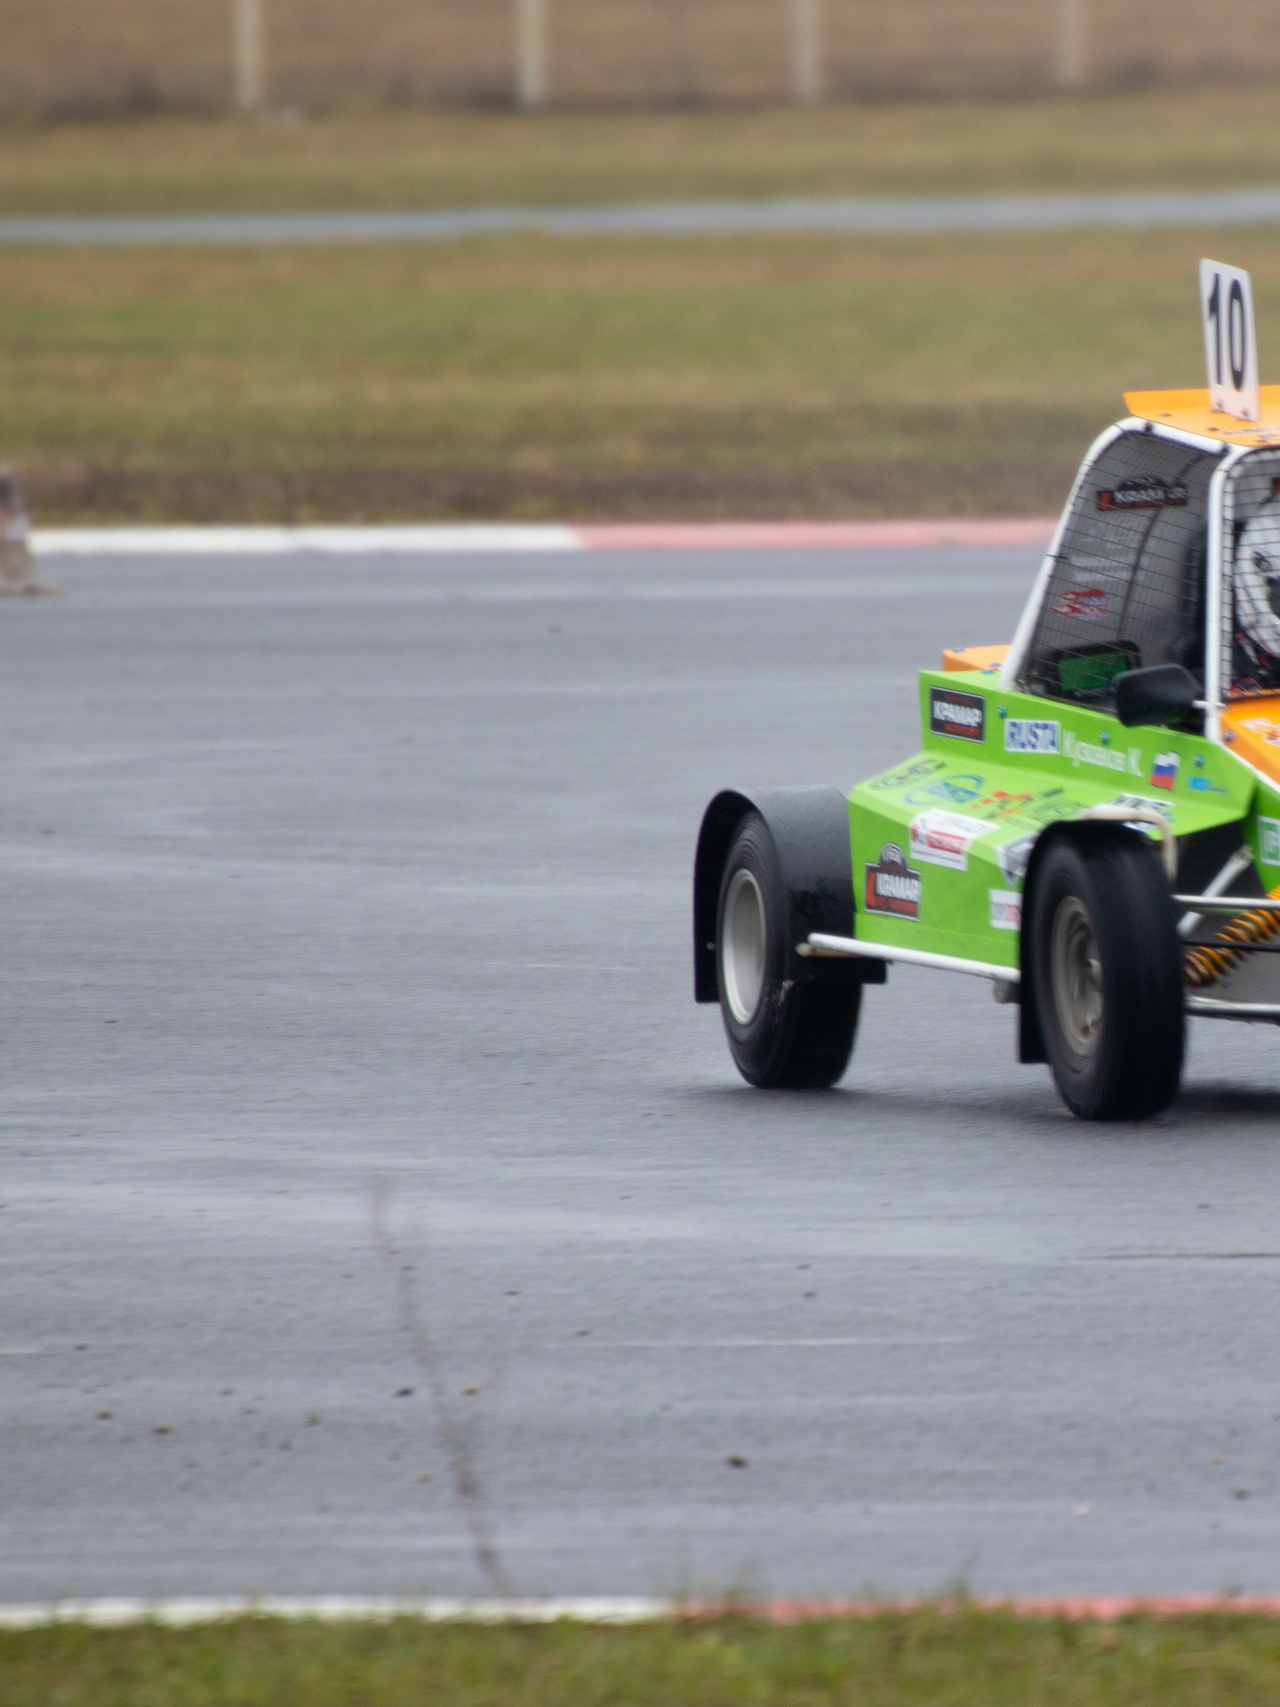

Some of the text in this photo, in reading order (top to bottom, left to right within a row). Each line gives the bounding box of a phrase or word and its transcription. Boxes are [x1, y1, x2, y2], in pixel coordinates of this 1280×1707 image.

[1207, 271, 1246, 393] 10
[1008, 720, 1058, 750] RUSTA
[876, 871, 921, 902] KRAMAR
